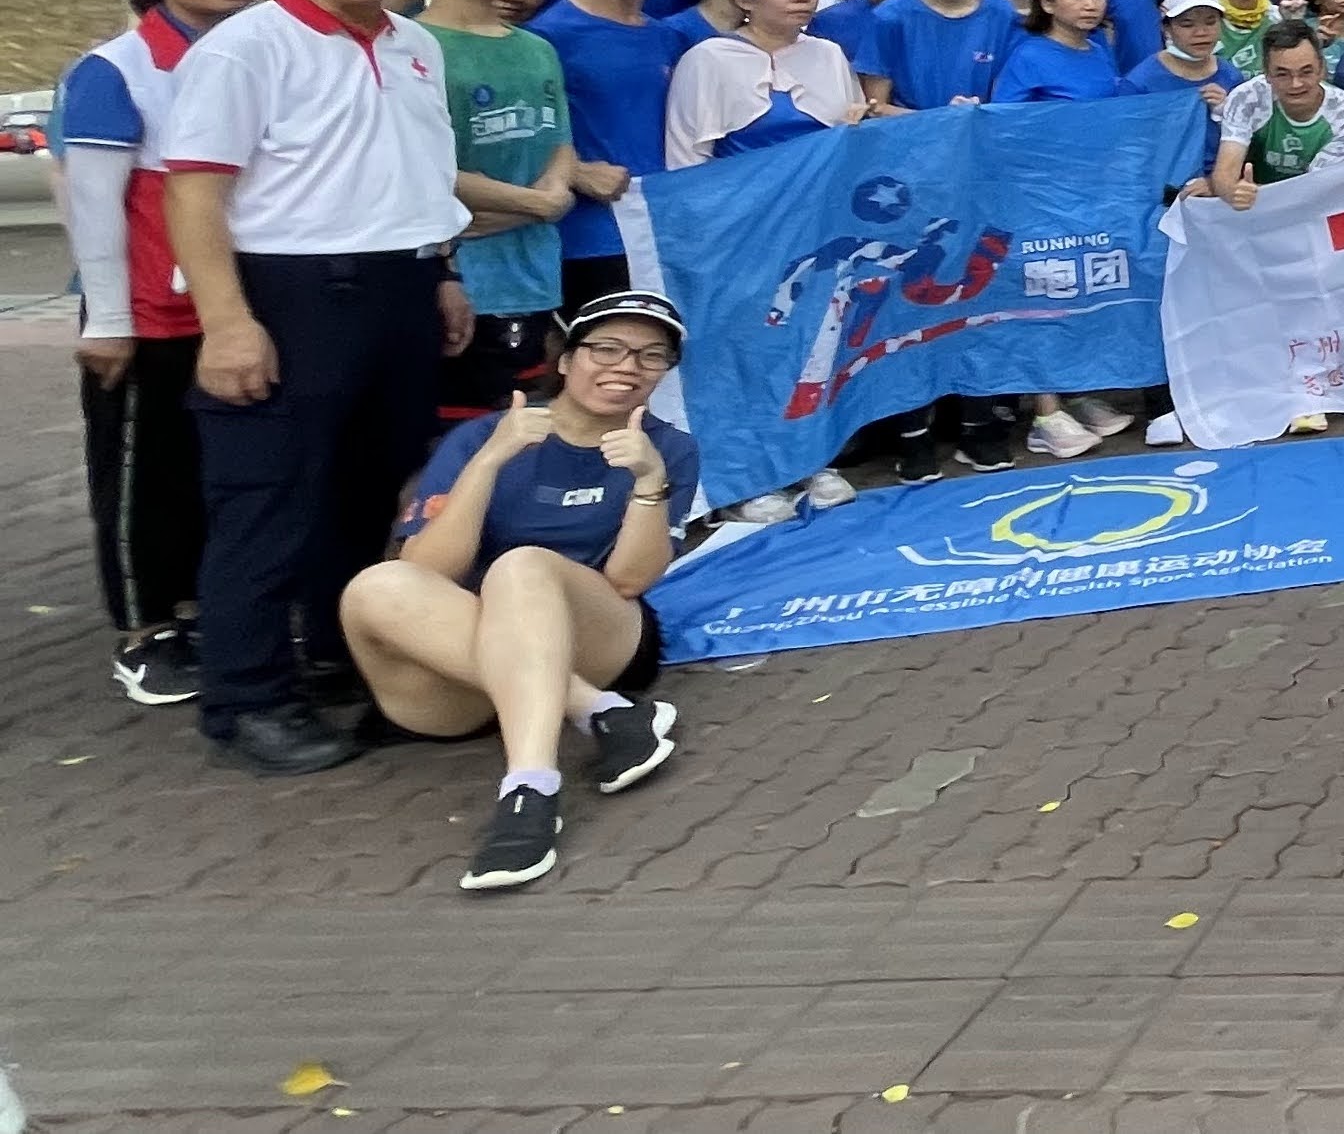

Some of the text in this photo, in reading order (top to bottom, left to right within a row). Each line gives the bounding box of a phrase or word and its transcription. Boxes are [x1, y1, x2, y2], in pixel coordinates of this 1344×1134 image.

[1020, 232, 1111, 255] RUNNING
[1023, 249, 1131, 299] 跑团
[869, 594, 1010, 616] essible
[1039, 579, 1122, 596] Health
